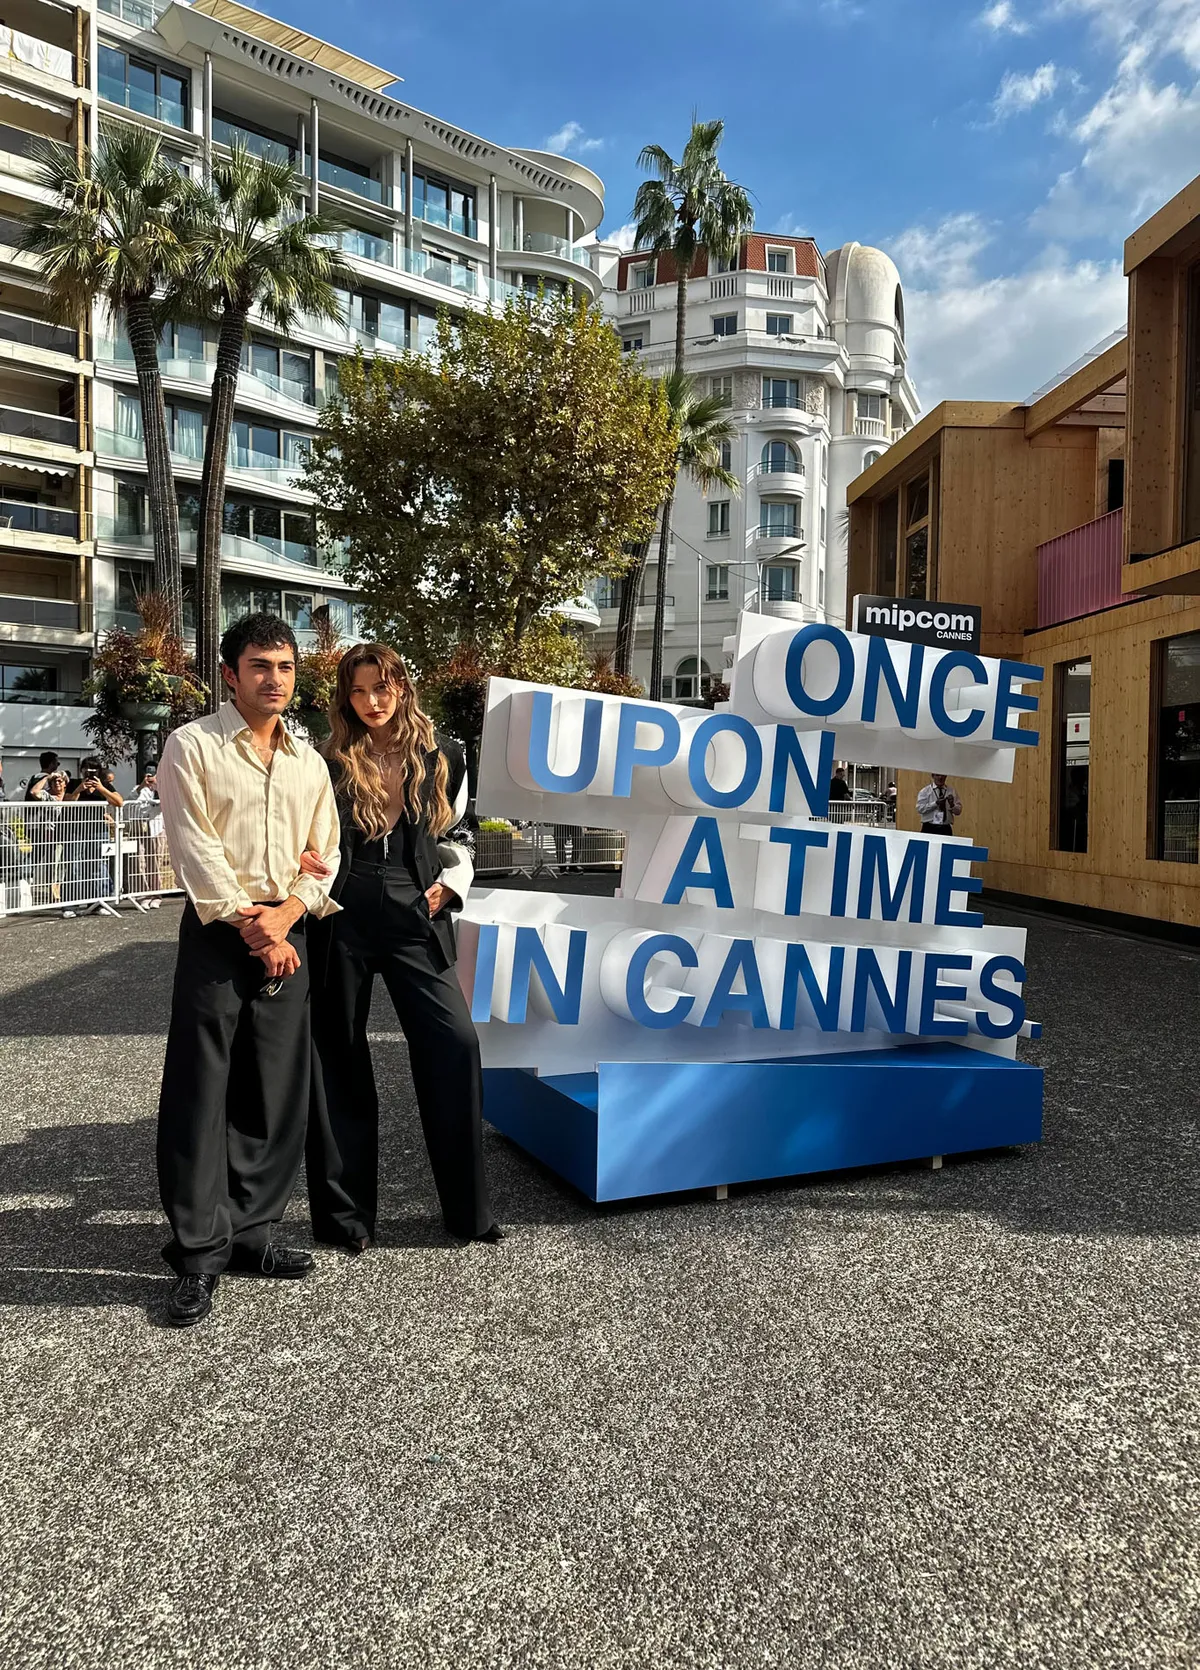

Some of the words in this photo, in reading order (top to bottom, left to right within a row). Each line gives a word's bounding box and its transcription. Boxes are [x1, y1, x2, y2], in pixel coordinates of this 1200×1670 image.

[865, 603, 974, 632] mipcom
[936, 630, 973, 641] CANNES
[785, 623, 1044, 747] ONCE
[528, 691, 835, 817] UPON
[662, 817, 734, 909] A
[769, 826, 989, 928] TIME
[471, 926, 587, 1025] IN
[625, 935, 1042, 1039] CANNES.
